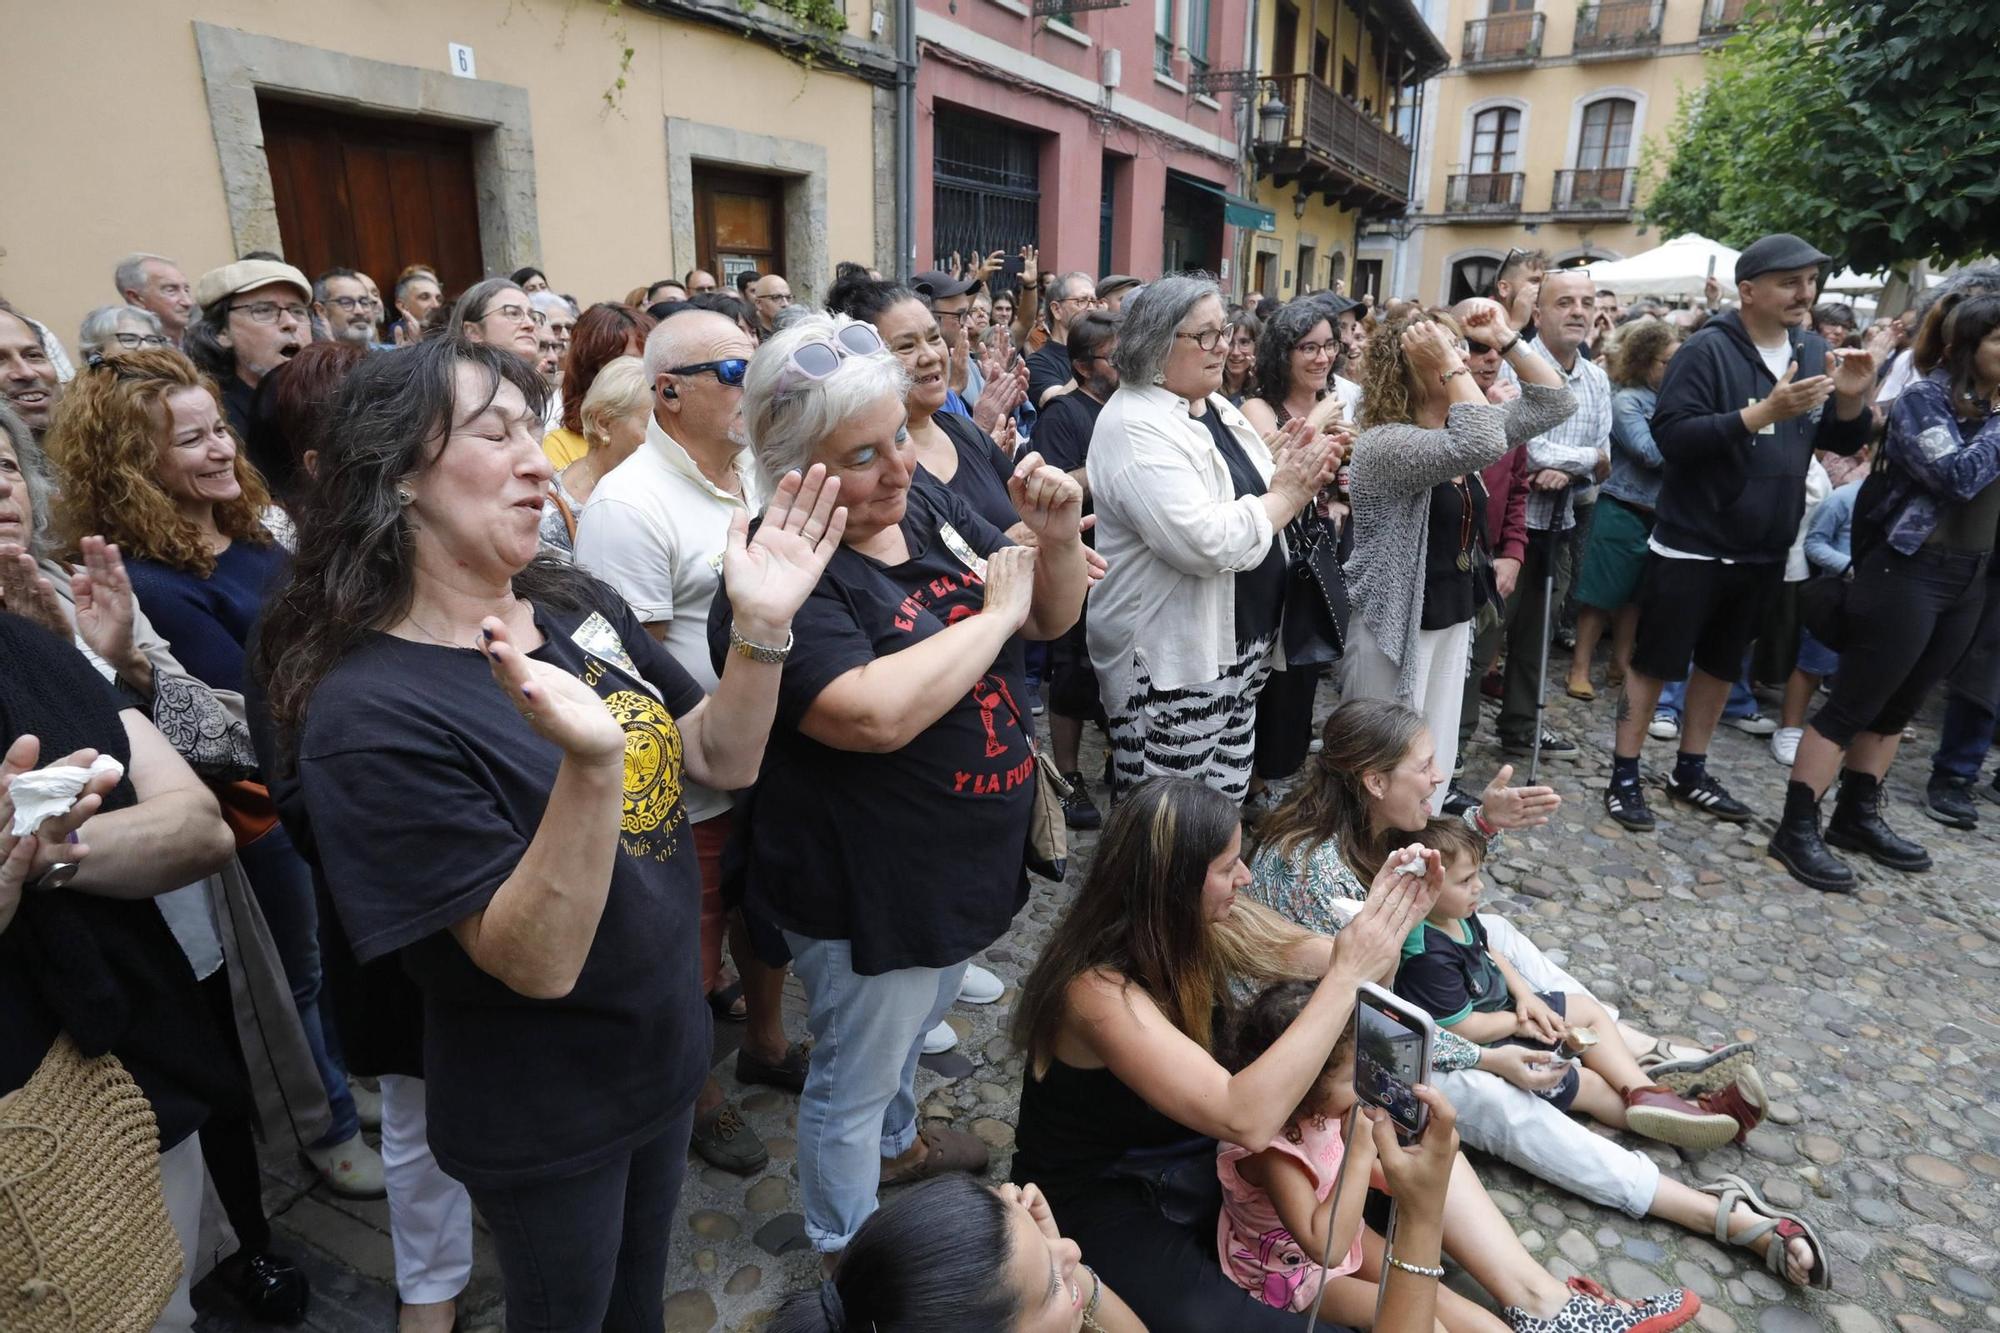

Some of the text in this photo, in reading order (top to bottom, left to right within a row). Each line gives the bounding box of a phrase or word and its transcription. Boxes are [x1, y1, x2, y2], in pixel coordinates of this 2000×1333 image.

[458, 49, 468, 72] 6
[929, 575, 958, 598] EL
[953, 770, 972, 792] Y
[973, 773, 1001, 794] LA
